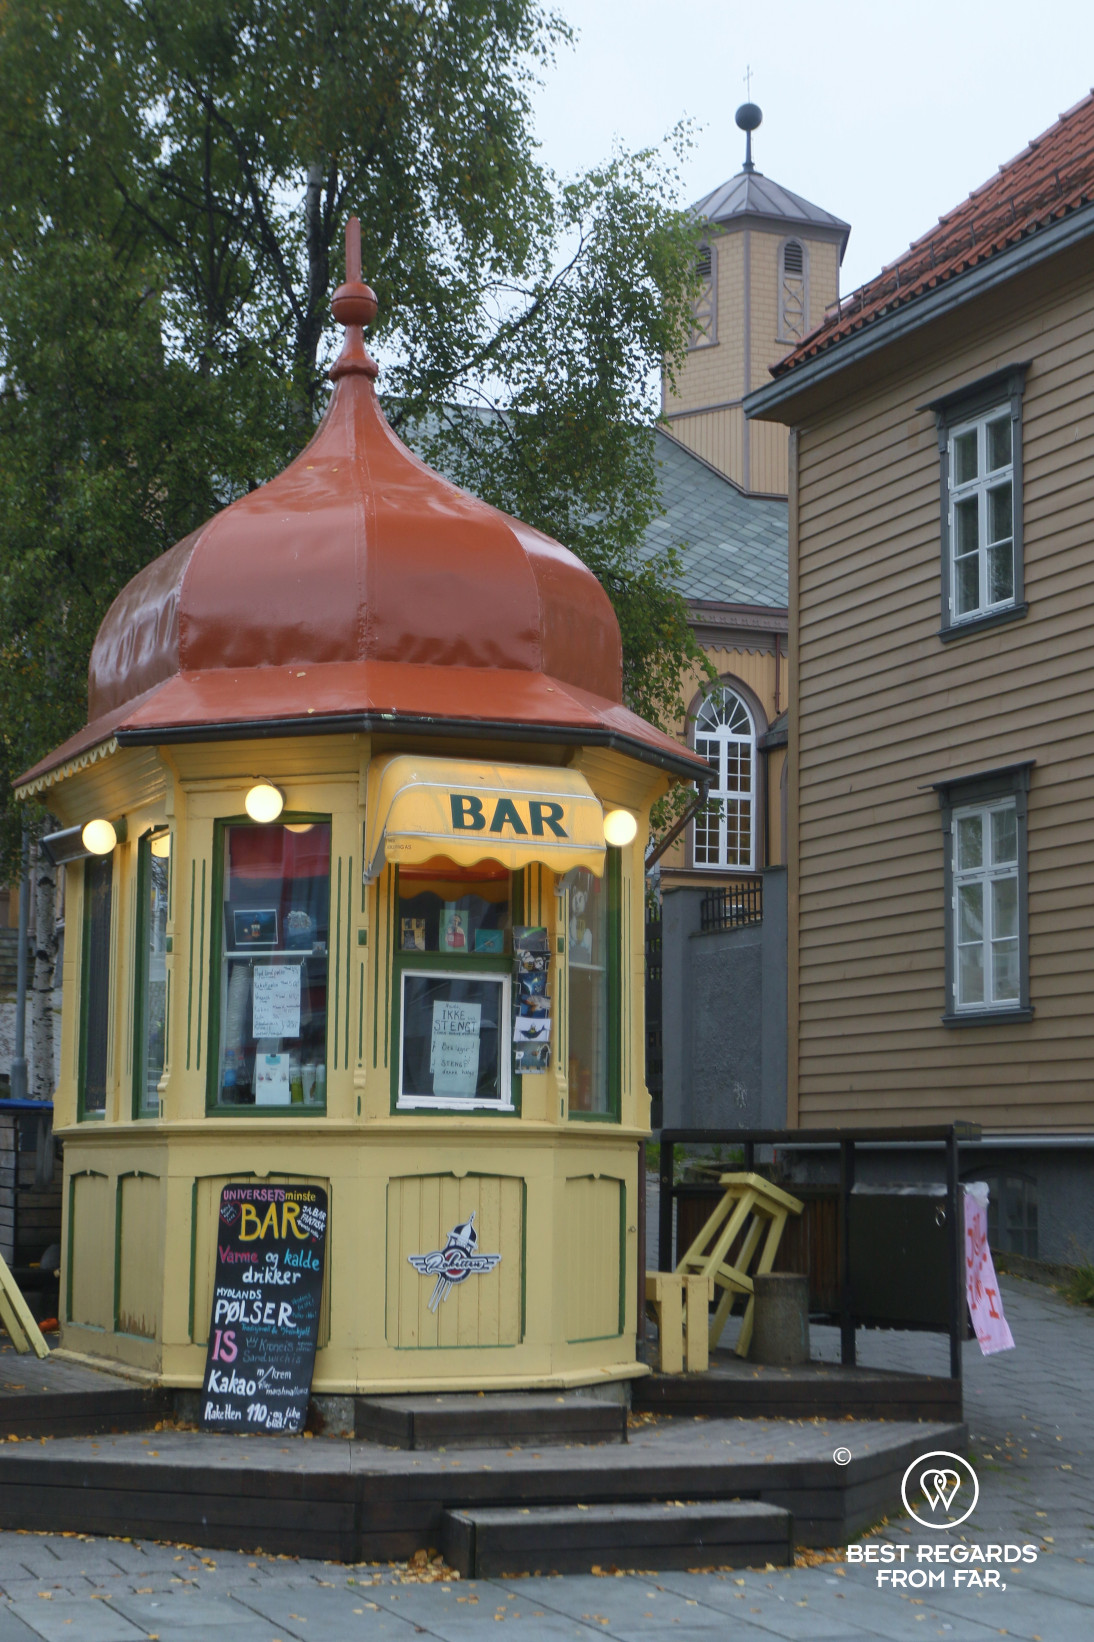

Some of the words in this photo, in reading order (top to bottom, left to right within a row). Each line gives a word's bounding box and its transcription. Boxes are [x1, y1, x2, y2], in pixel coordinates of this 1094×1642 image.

[450, 794, 569, 838] BAR
[434, 1020, 477, 1033] STENGT
[442, 1009, 465, 1020] IKKE
[223, 1188, 285, 1202] UNIVERSETS
[285, 1190, 316, 1202] minste
[238, 1201, 310, 1241] BAR
[219, 1244, 259, 1264] Varme
[265, 1252, 279, 1271] og
[283, 1248, 320, 1272] kalde
[426, 1251, 483, 1272] Raketten
[242, 1265, 302, 1285] drikker
[214, 1299, 297, 1328] PØLSER
[211, 1329, 238, 1363] IS
[207, 1368, 257, 1396] Kakao
[204, 1401, 242, 1421] Raketten
[246, 1403, 268, 1422] 110
